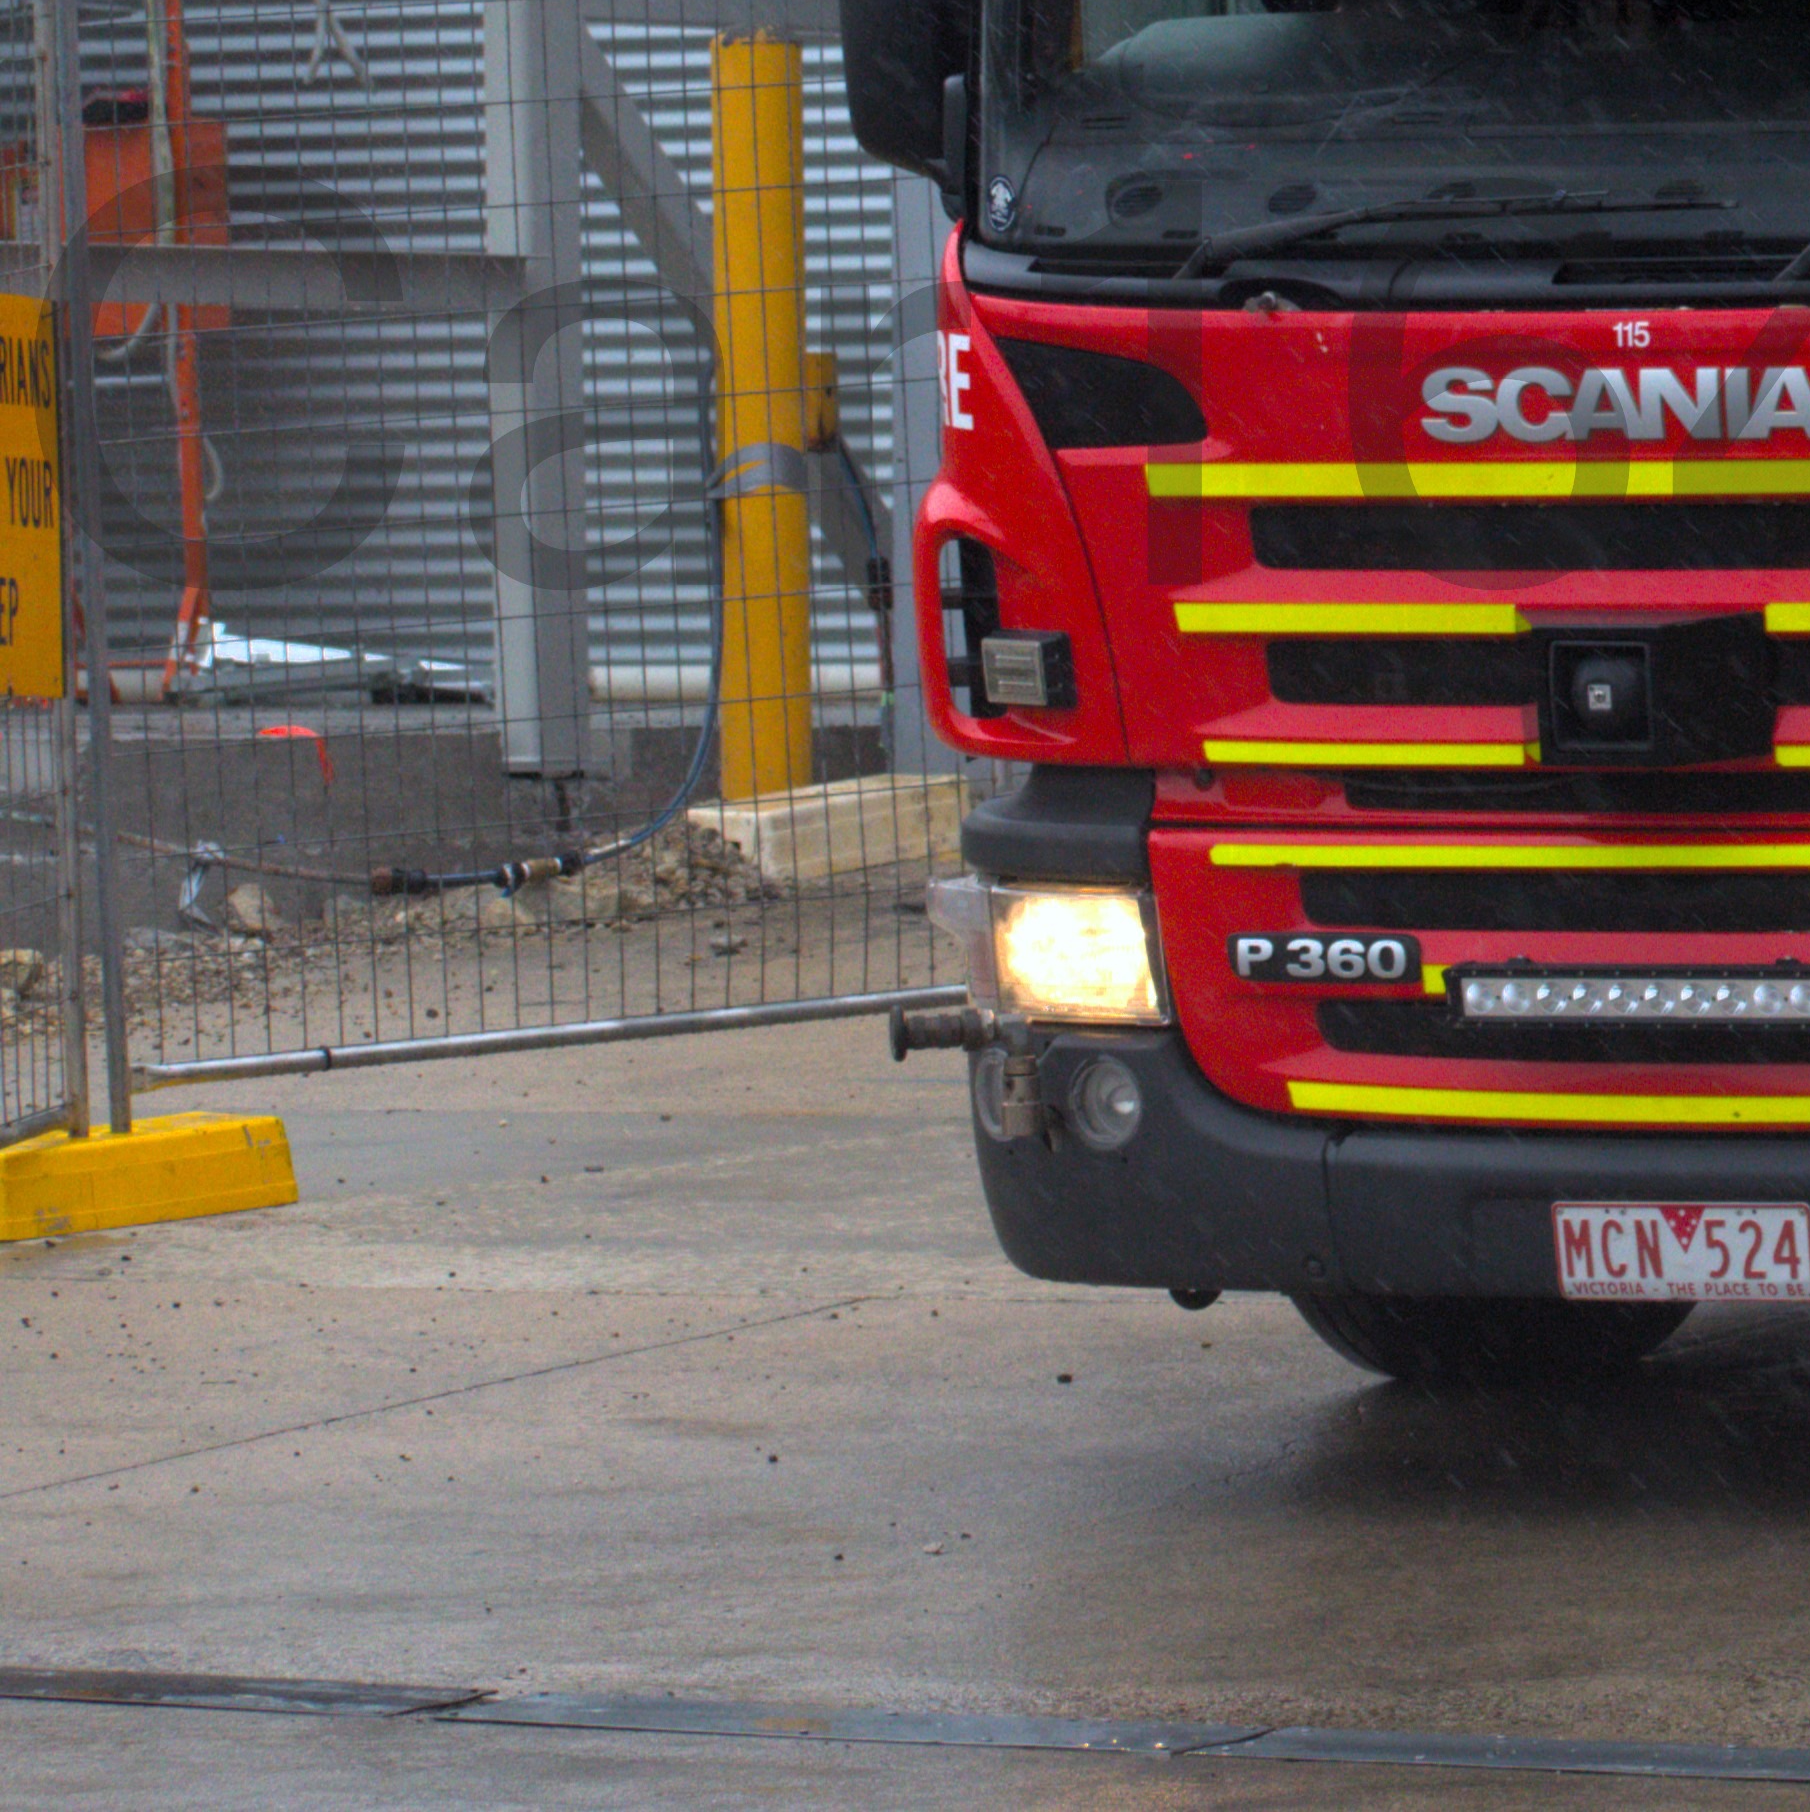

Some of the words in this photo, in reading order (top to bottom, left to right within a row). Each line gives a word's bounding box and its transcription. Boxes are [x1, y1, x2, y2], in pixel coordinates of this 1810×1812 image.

[1611, 320, 1650, 350] 115
[5, 456, 54, 528] YOUR
[1236, 938, 1274, 977] P
[1286, 938, 1407, 979] 360
[1562, 1219, 1664, 1279] MCN
[1704, 1219, 1801, 1279] 524
[1572, 1281, 1645, 1297] VICTORIA
[1666, 1281, 1696, 1297] THE
[1704, 1281, 1750, 1297] PLACE
[1758, 1281, 1778, 1297] TO
[1786, 1281, 1806, 1297] BE
